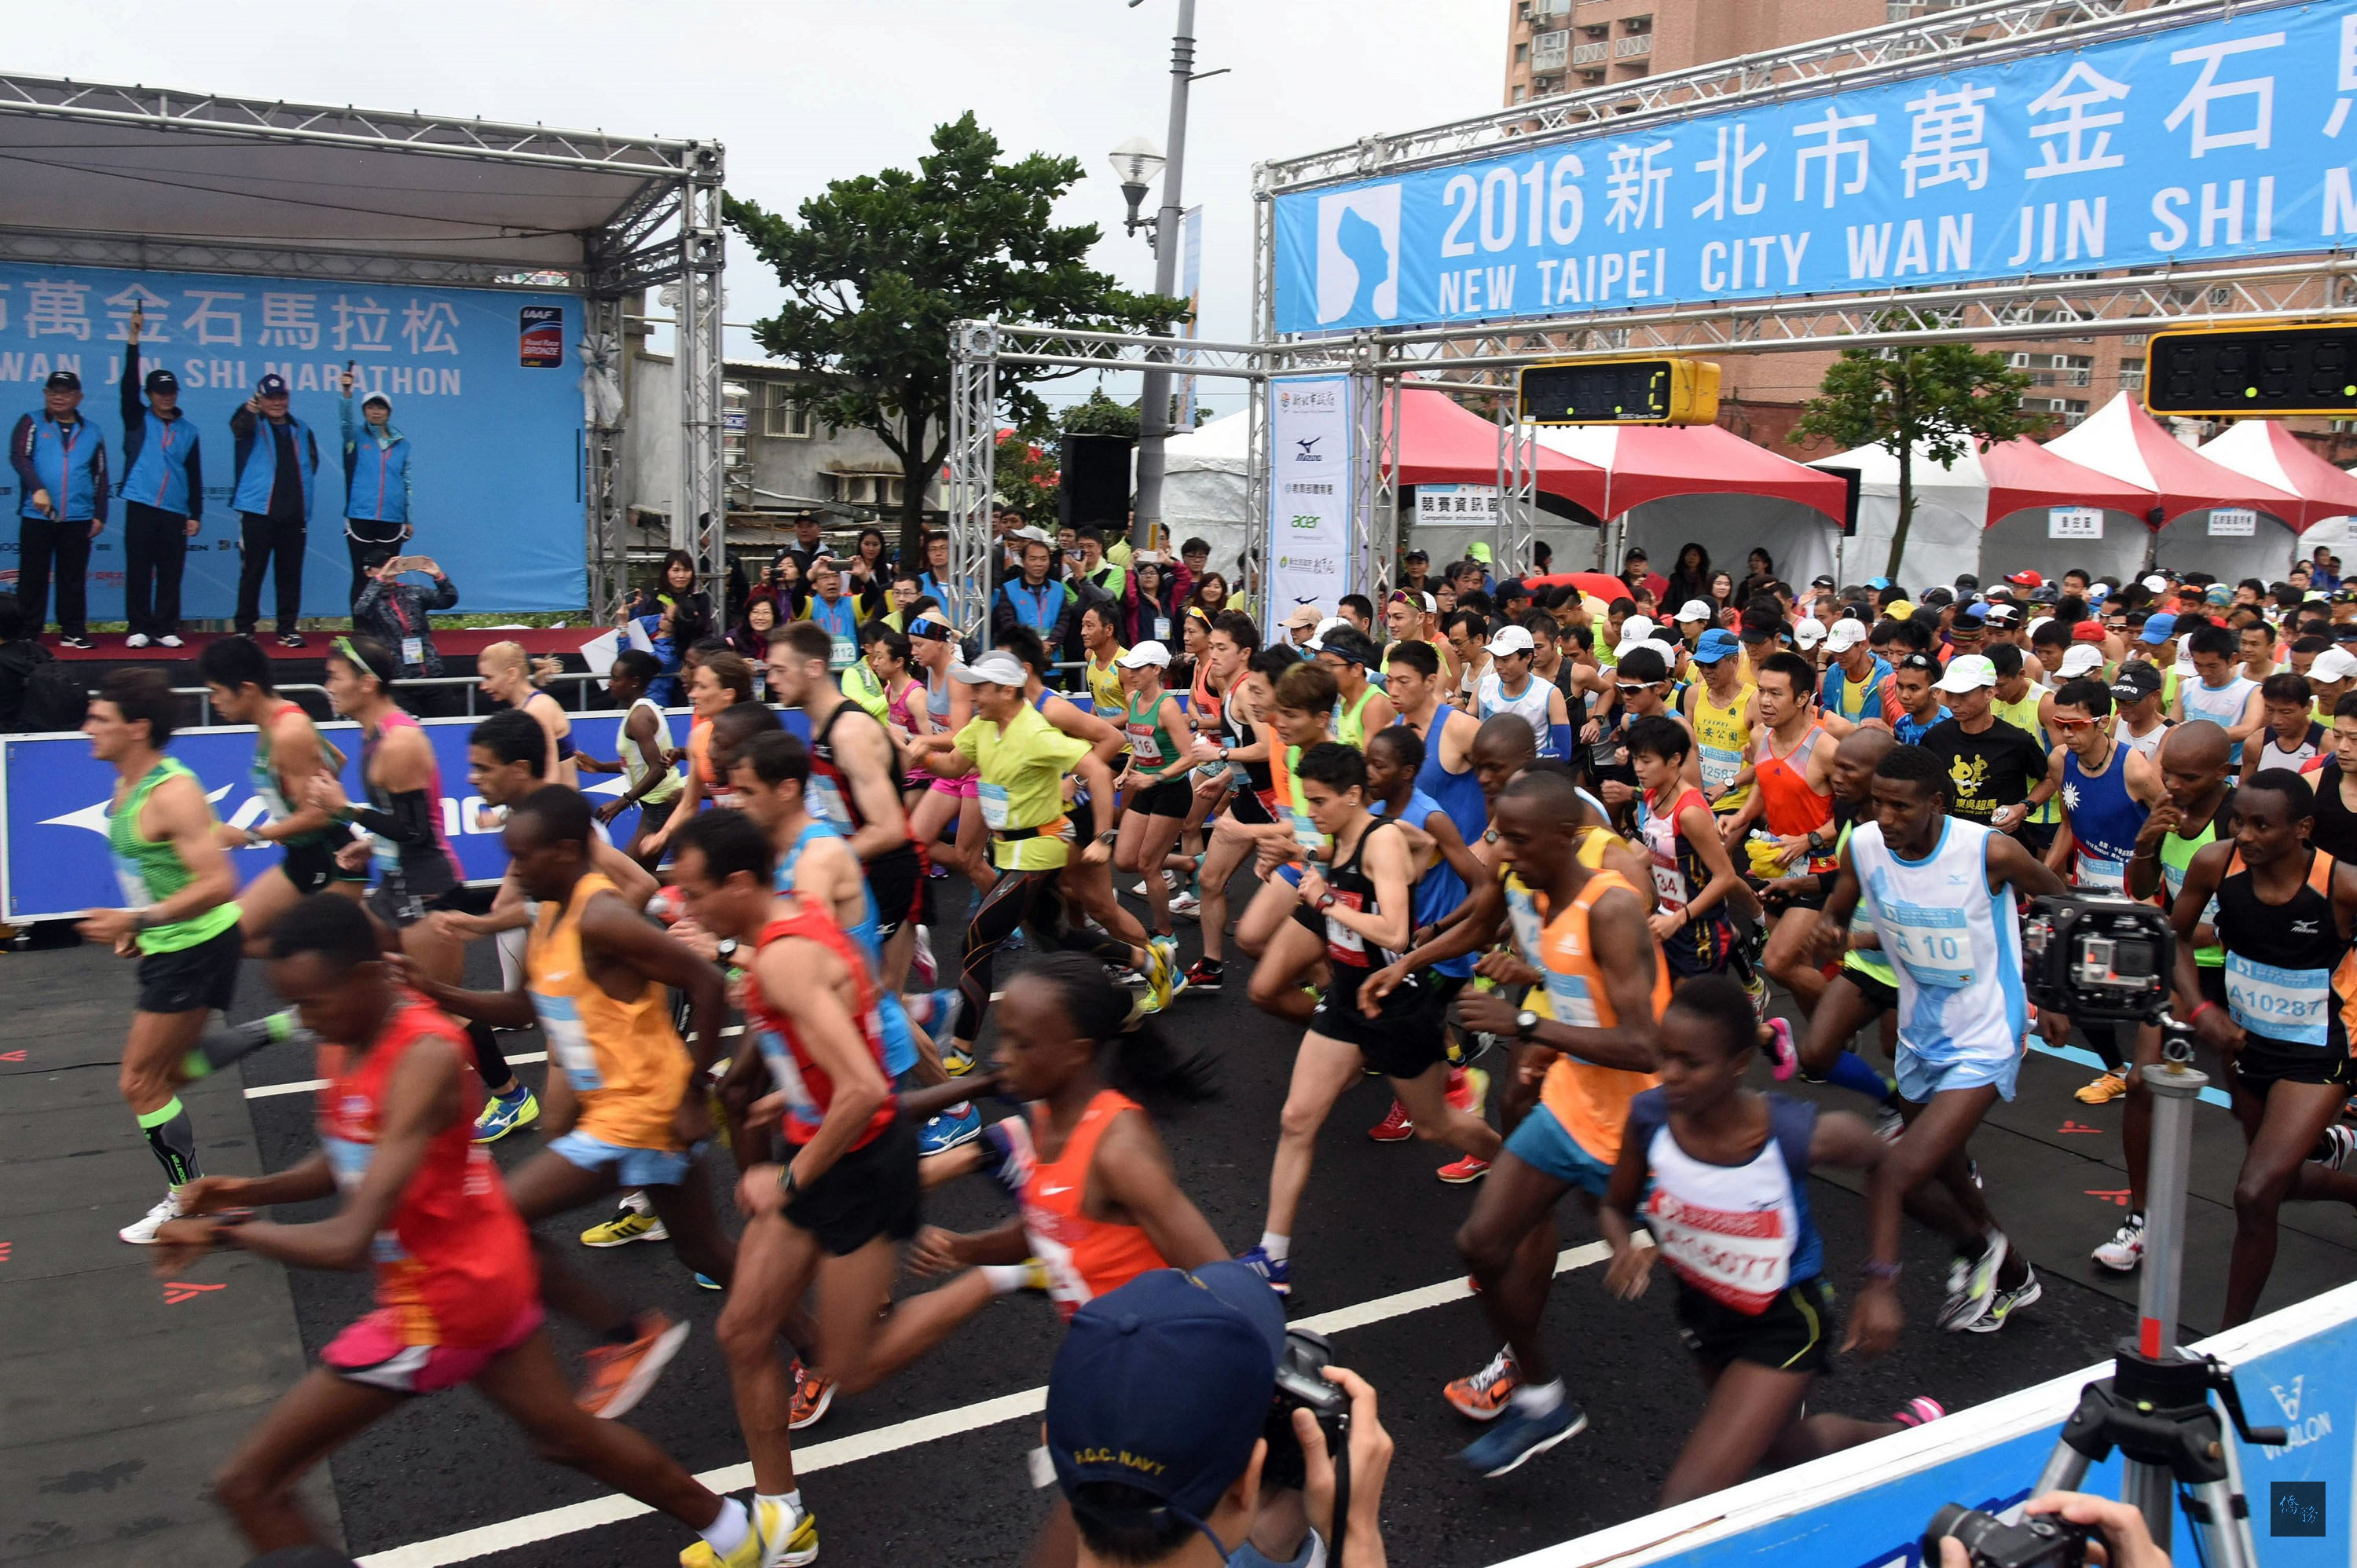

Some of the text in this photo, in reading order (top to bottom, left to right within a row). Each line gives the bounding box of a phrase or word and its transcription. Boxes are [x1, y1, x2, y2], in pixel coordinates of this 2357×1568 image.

[1440, 154, 1585, 258] 2016
[1439, 266, 1517, 314] NEW
[1536, 247, 1666, 306] TAIPEI
[1700, 232, 1811, 292] CITY
[1846, 214, 1974, 280] WAN
[2009, 196, 2108, 266] JIN
[2149, 175, 2275, 251] SHI
[0, 277, 460, 355] 萬金石馬拉松
[522, 310, 554, 319] IAAF
[523, 346, 559, 356] BRONZE
[185, 359, 247, 389] SHI
[1291, 515, 1321, 529] acer
[1955, 798, 1997, 811] 東吳超馬
[1897, 929, 1959, 960] A 10
[2230, 984, 2322, 1017] A10287
[1119, 1450, 1166, 1475] NAVY
